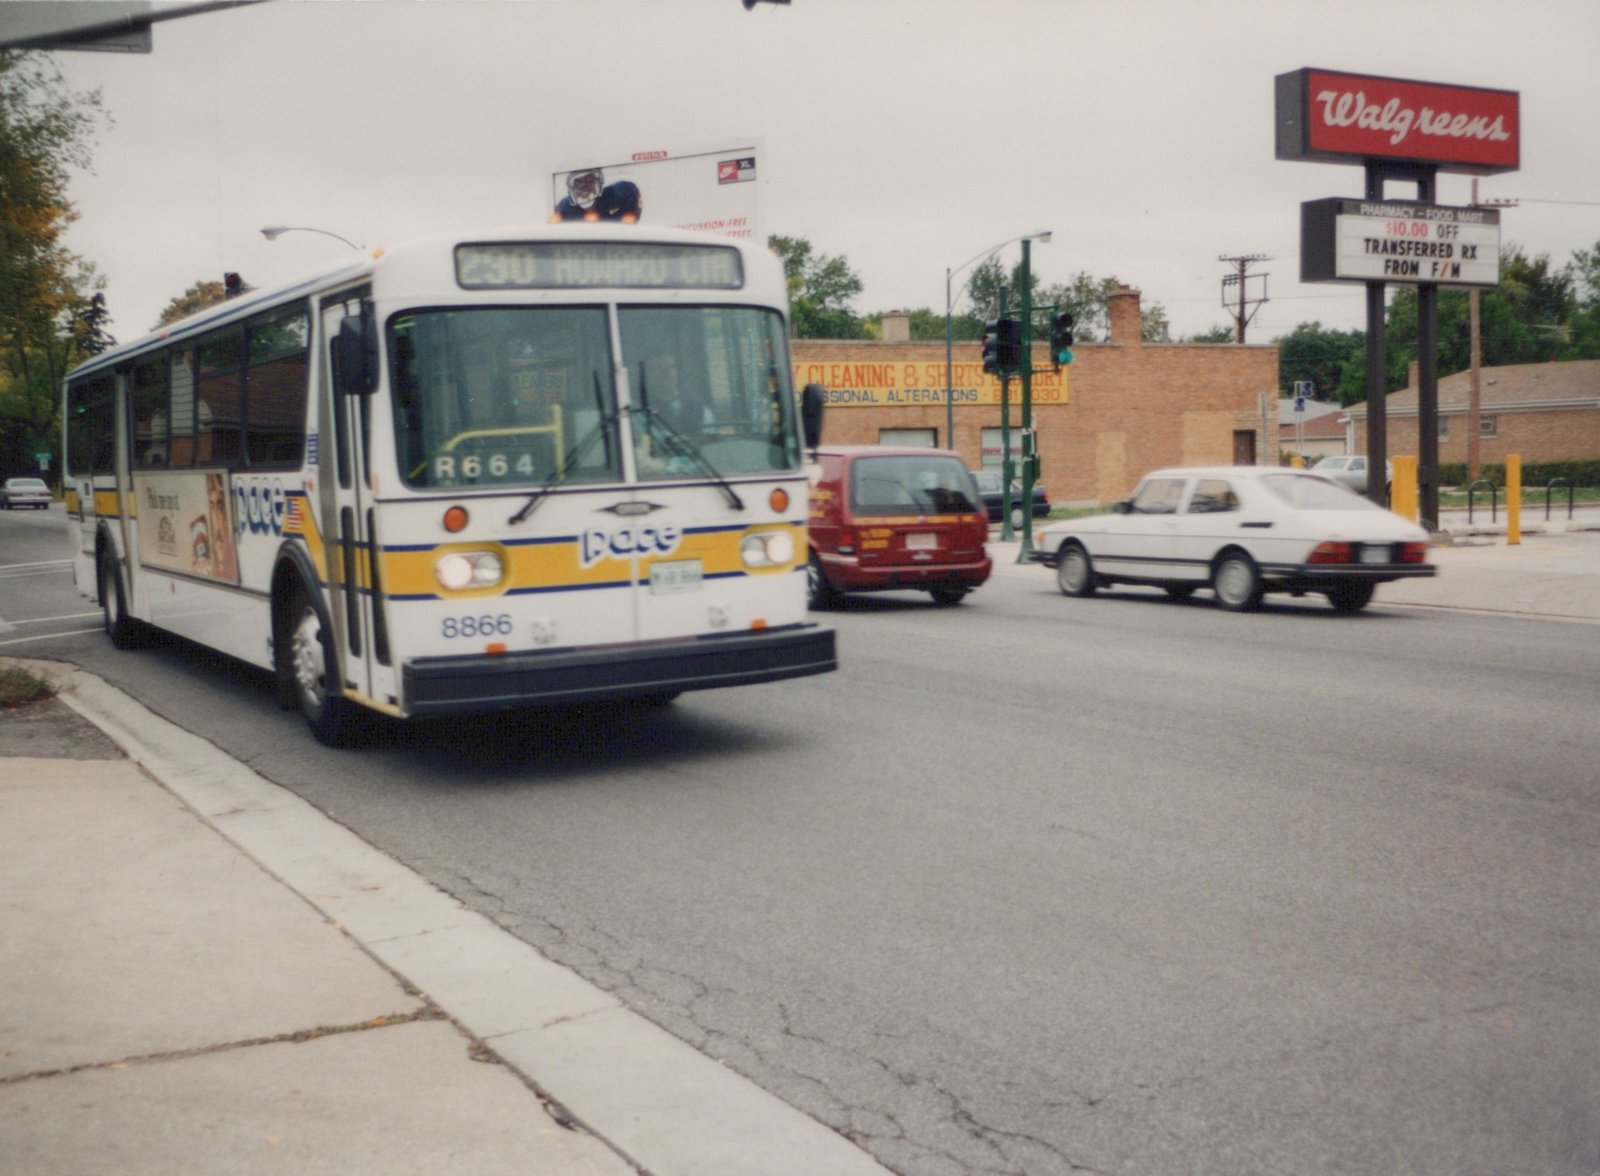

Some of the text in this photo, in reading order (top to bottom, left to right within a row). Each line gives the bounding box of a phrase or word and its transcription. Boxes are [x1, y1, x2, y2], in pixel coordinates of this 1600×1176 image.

[1316, 91, 1510, 145] Walgreens
[740, 160, 751, 168] XL
[1360, 204, 1414, 218] PHARMACY
[1426, 209, 1454, 221] FOOD
[1457, 211, 1484, 223] MART
[1386, 221, 1459, 239] $10.00 OFF
[1364, 239, 1477, 259] TRANSFERRED RX
[1384, 260, 1460, 278] FROM F/M
[808, 364, 895, 388] CLEANING
[903, 364, 919, 388] &
[925, 364, 984, 388] SHRTS
[887, 389, 978, 402] ALTERATONS
[580, 525, 681, 567] pace
[442, 614, 513, 639] 8866
